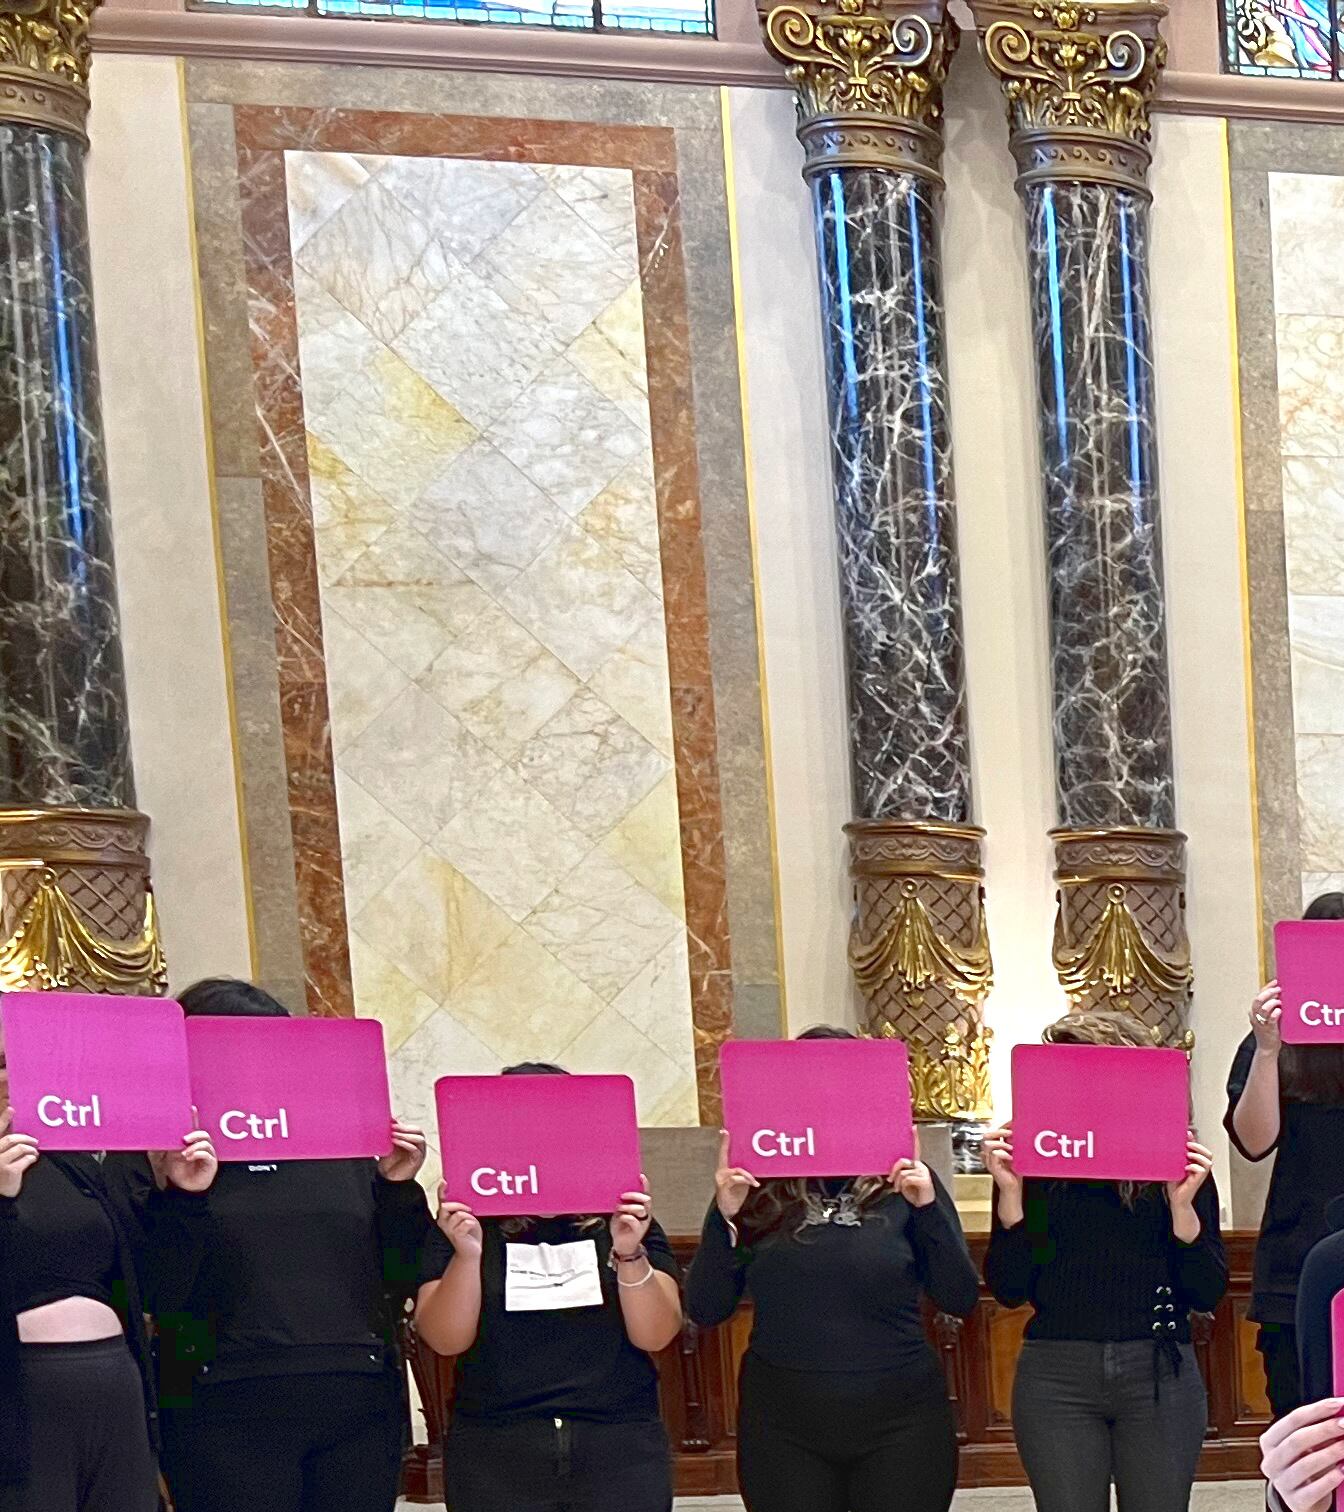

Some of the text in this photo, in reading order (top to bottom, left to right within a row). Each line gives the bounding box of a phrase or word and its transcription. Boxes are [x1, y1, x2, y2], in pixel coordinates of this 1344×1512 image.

[37, 1094, 101, 1127] Ctrl
[219, 1108, 289, 1140] Ctrl
[751, 1127, 814, 1157] Ctrl
[1034, 1130, 1094, 1158] Ctrl
[470, 1164, 538, 1196] Ctrl
